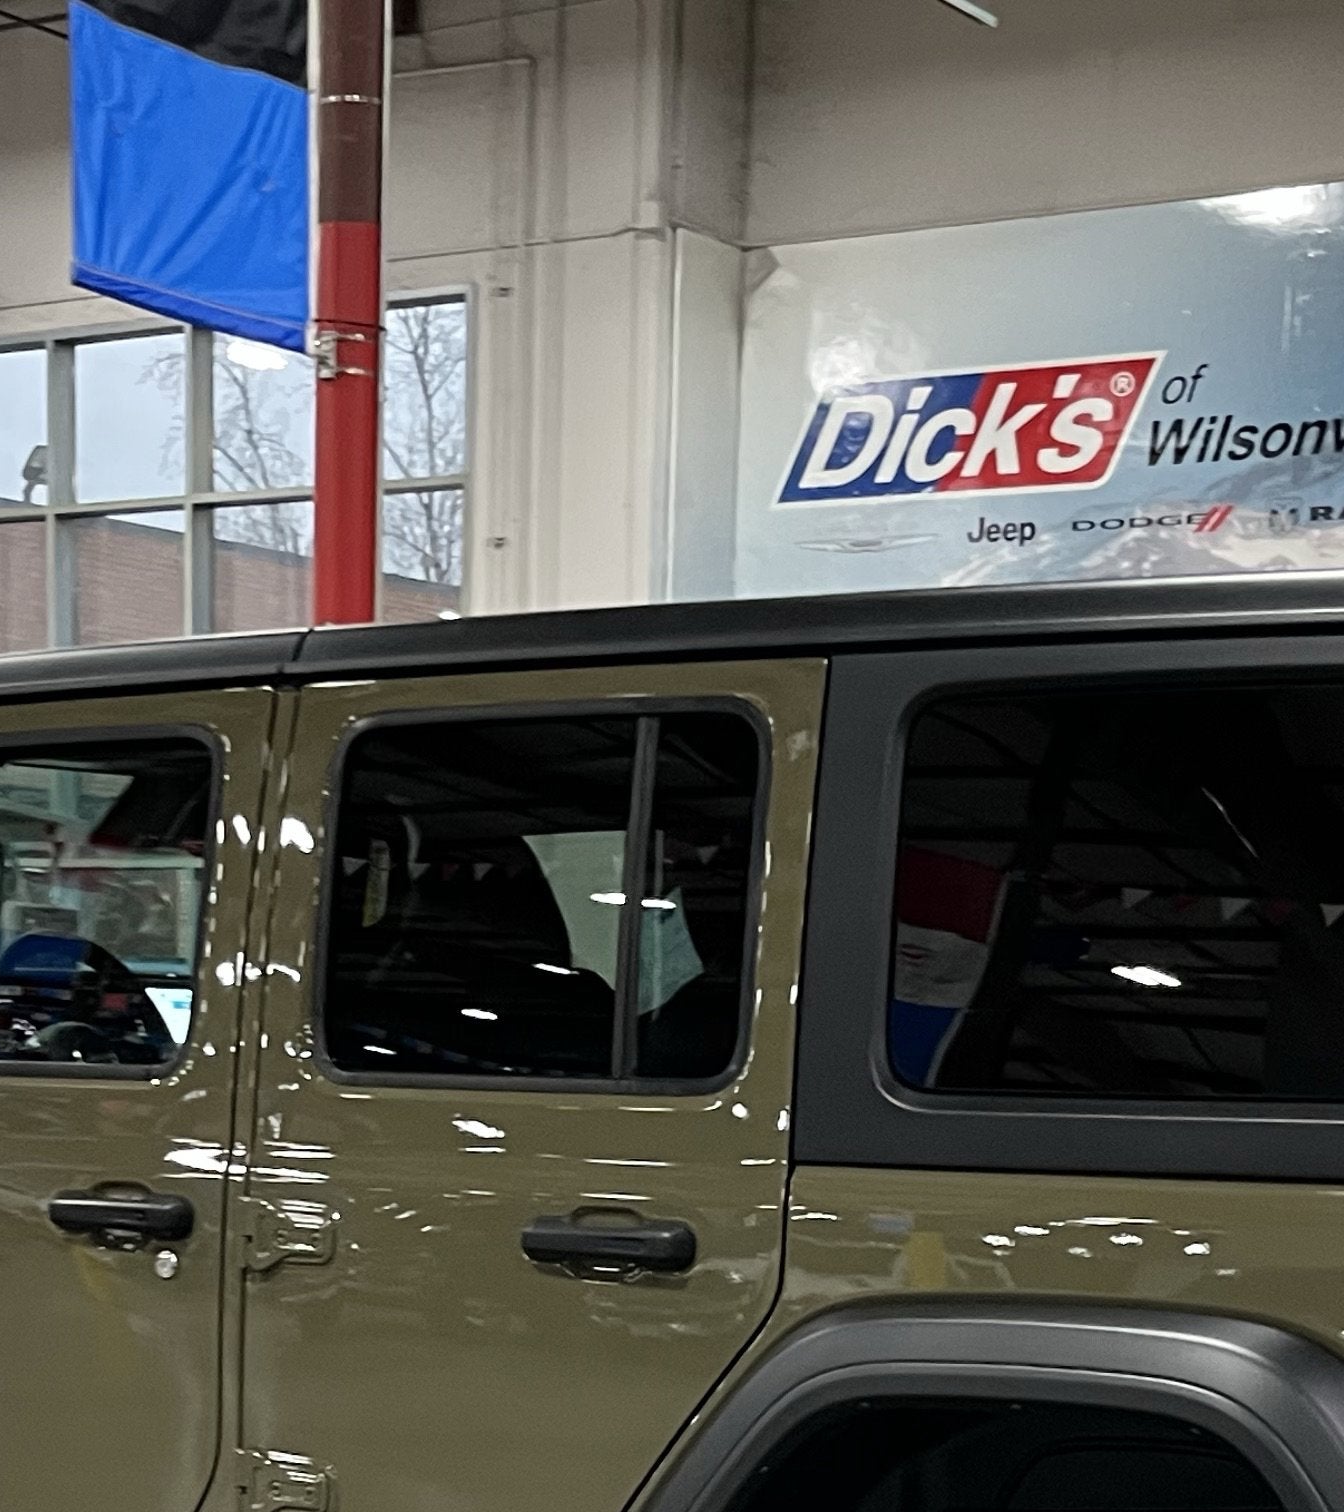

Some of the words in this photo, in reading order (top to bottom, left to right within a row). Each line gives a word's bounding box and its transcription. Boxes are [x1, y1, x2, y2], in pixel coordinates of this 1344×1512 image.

[1161, 363, 1209, 405] of
[967, 517, 1036, 546] Jeep
[1072, 513, 1208, 532] DODGE
